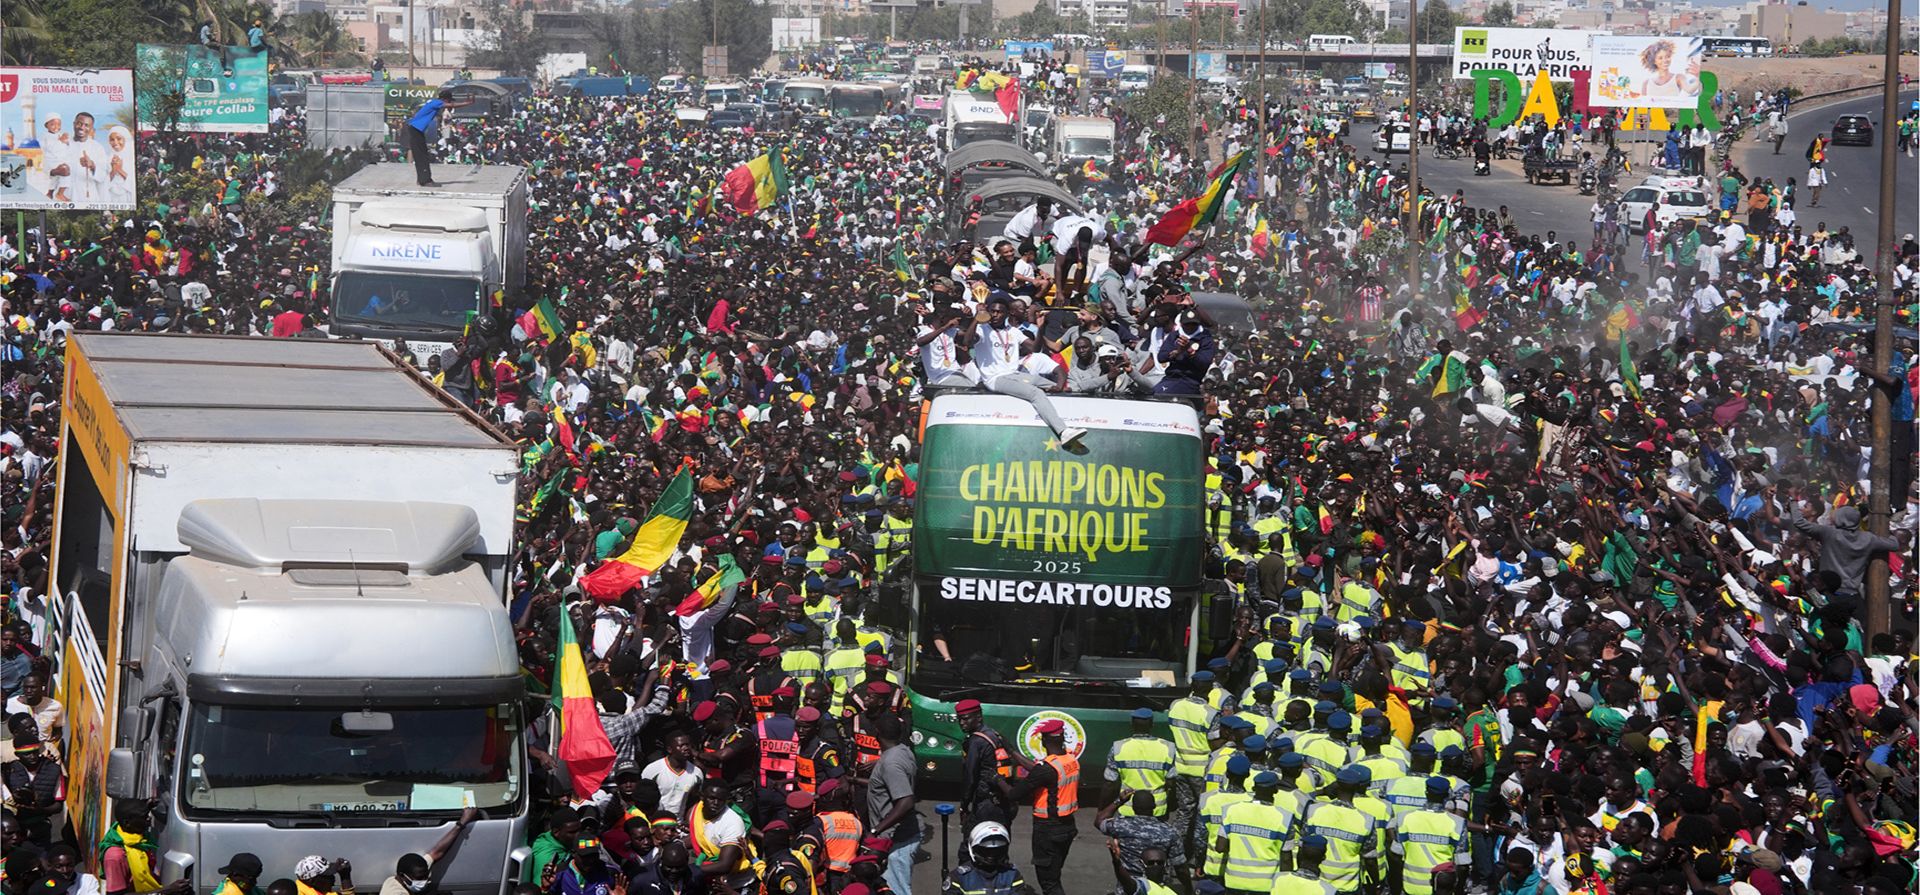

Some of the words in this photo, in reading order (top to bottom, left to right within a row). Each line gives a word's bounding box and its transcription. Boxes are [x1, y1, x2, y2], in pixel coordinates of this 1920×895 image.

[1463, 37, 1486, 46] RT
[1492, 48, 1533, 60] POUR
[32, 84, 49, 94] BON
[52, 85, 80, 94] MAGAL
[83, 86, 95, 94] DE
[97, 86, 124, 94] TOUBA
[388, 88, 402, 98] CI
[405, 89, 435, 98] KAW
[216, 103, 255, 115] Collab
[959, 460, 1166, 509] CHAMPIONS
[972, 506, 1150, 562] D'AFRIQUE
[1033, 560, 1082, 575] 2025
[940, 576, 1172, 610] SENECARTOURS
[762, 740, 797, 752] POLICE
[1230, 823, 1271, 839] GENDARMERIE
[1315, 826, 1359, 840] GENDARMERIE
